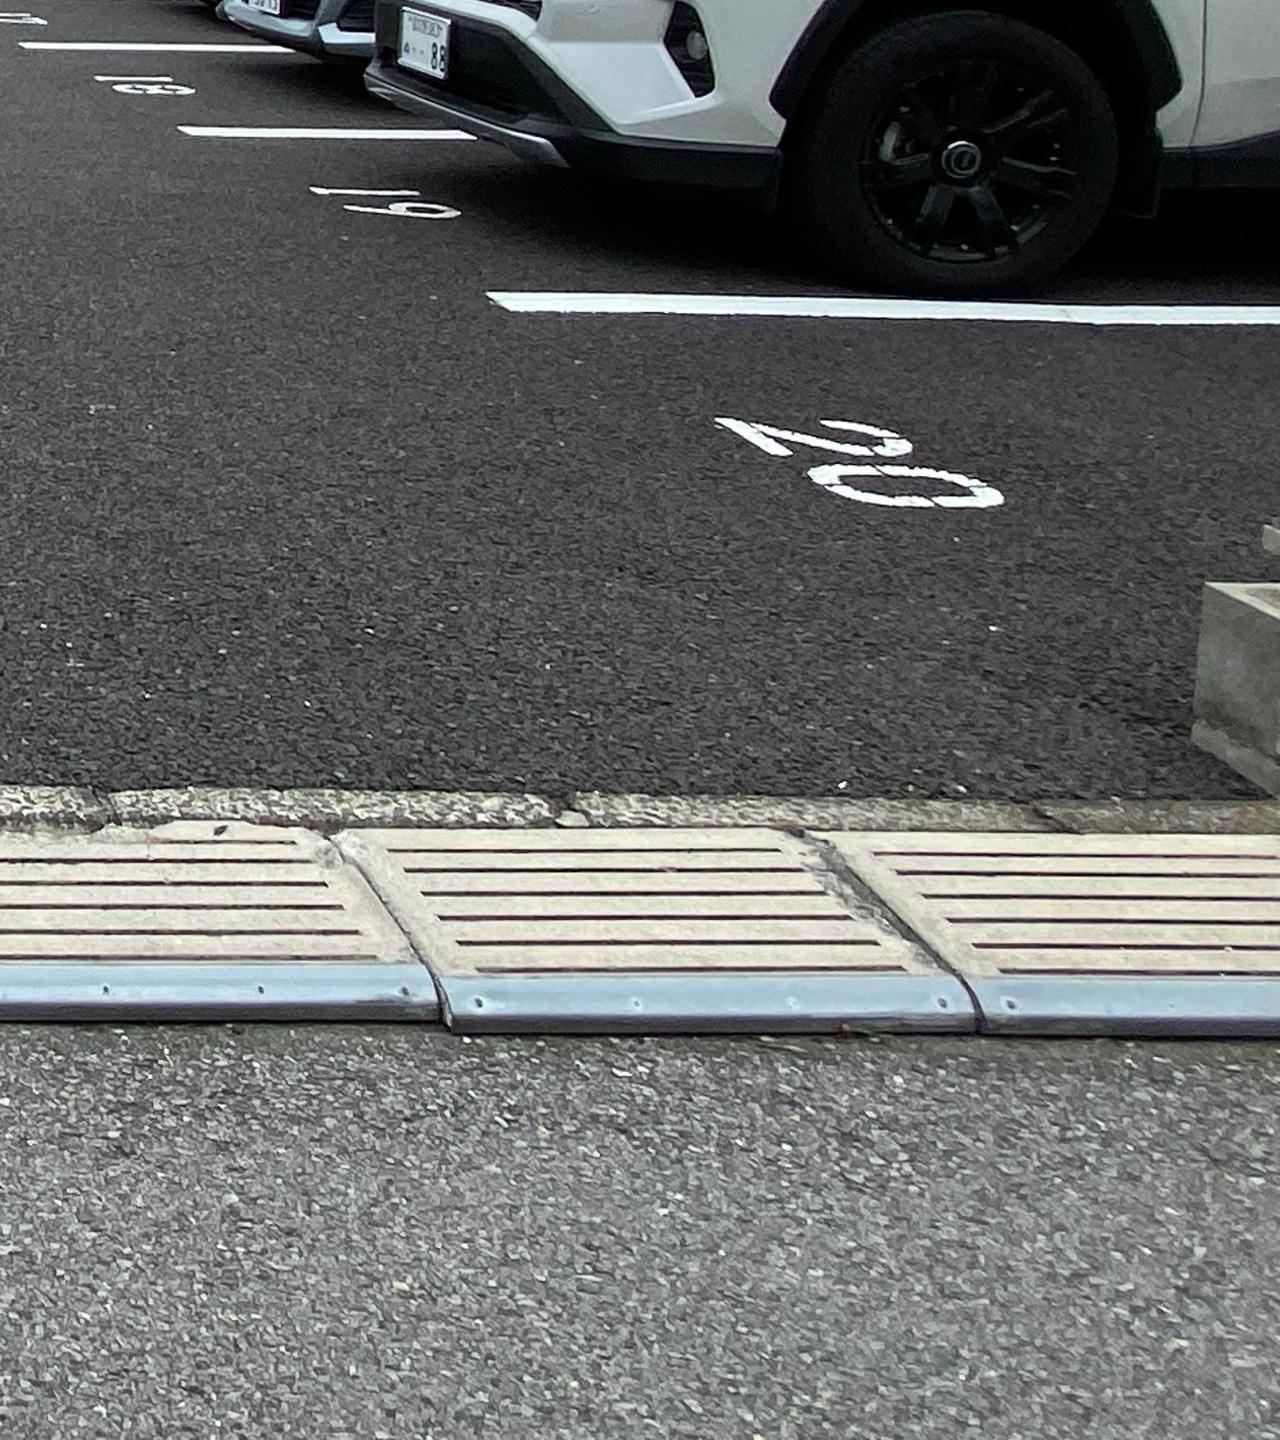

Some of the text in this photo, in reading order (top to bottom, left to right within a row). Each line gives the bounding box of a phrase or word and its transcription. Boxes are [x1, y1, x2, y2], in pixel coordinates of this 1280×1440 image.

[93, 74, 197, 96] 18
[308, 185, 463, 220] 19
[713, 415, 1006, 510] 20
